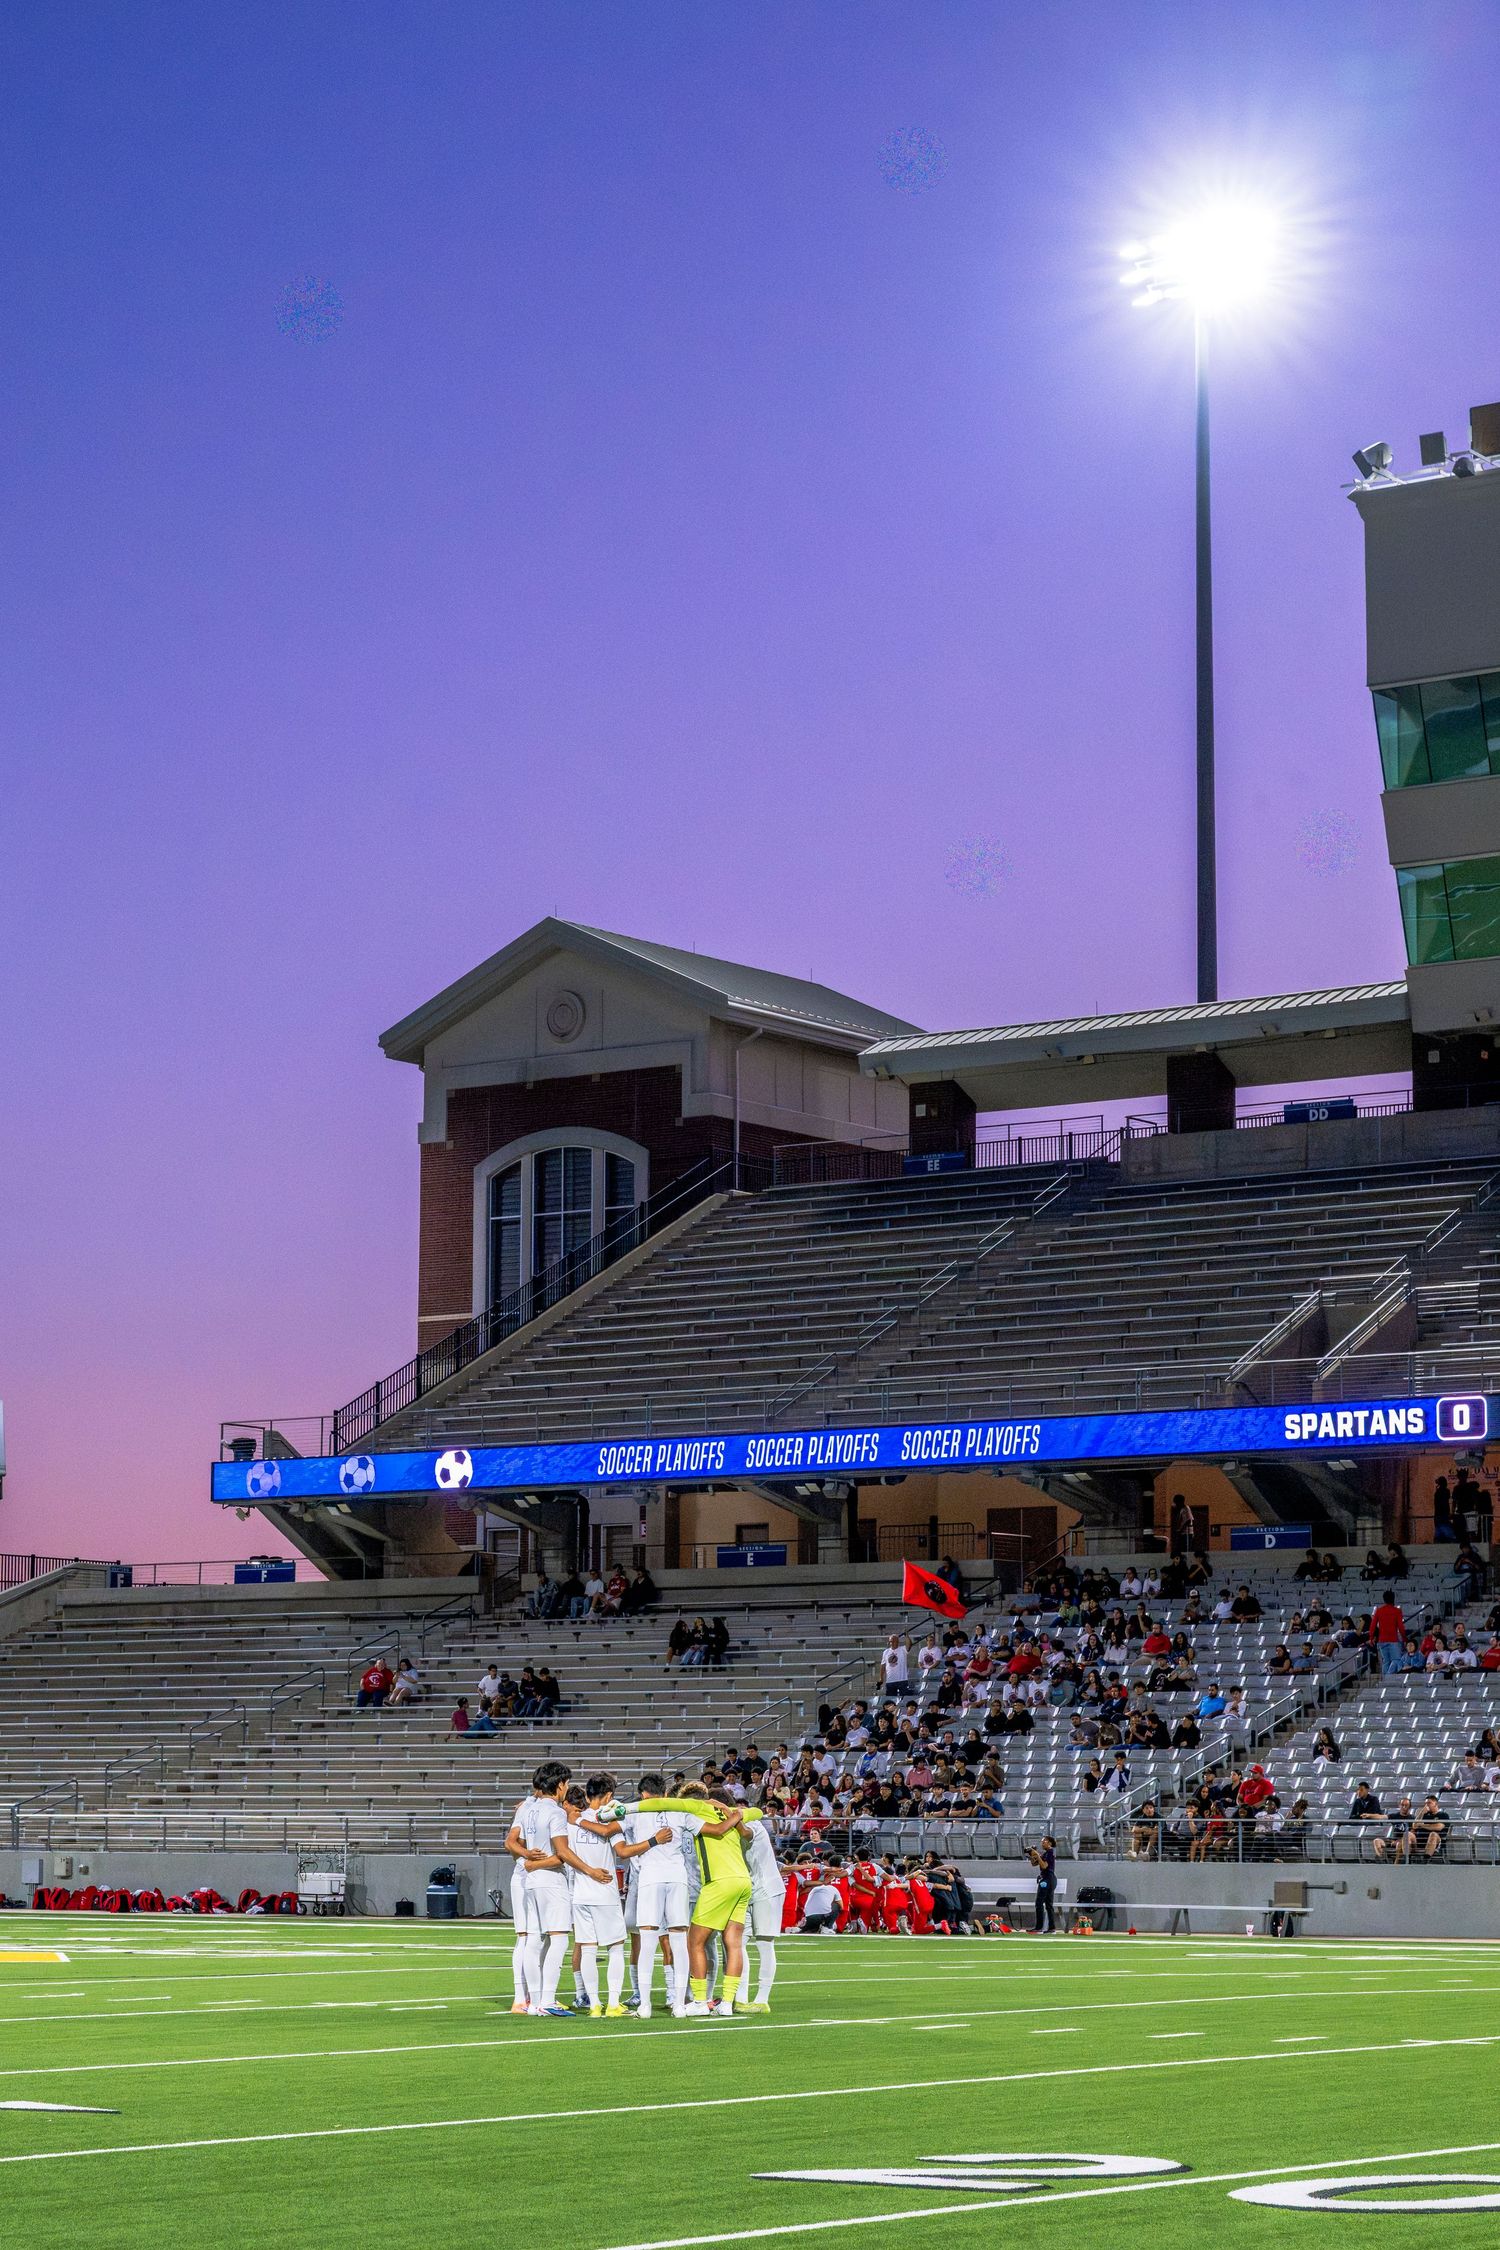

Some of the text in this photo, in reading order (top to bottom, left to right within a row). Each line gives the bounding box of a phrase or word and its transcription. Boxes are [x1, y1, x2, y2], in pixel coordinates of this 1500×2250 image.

[1308, 1108, 1329, 1122] DD
[927, 1160, 940, 1172] EE
[1284, 1407, 1424, 1440] SPARTANS
[1452, 1403, 1471, 1432] 0
[745, 1432, 880, 1468] SOCCER PLAYOFFS
[901, 1424, 1041, 1461] SOCCER PLAYOFFS
[597, 1441, 726, 1475] SOCCER PLAYOFFS
[1264, 1534, 1276, 1549] D
[746, 1552, 754, 1566] E
[116, 1573, 125, 1589] F
[261, 1570, 268, 1583] F
